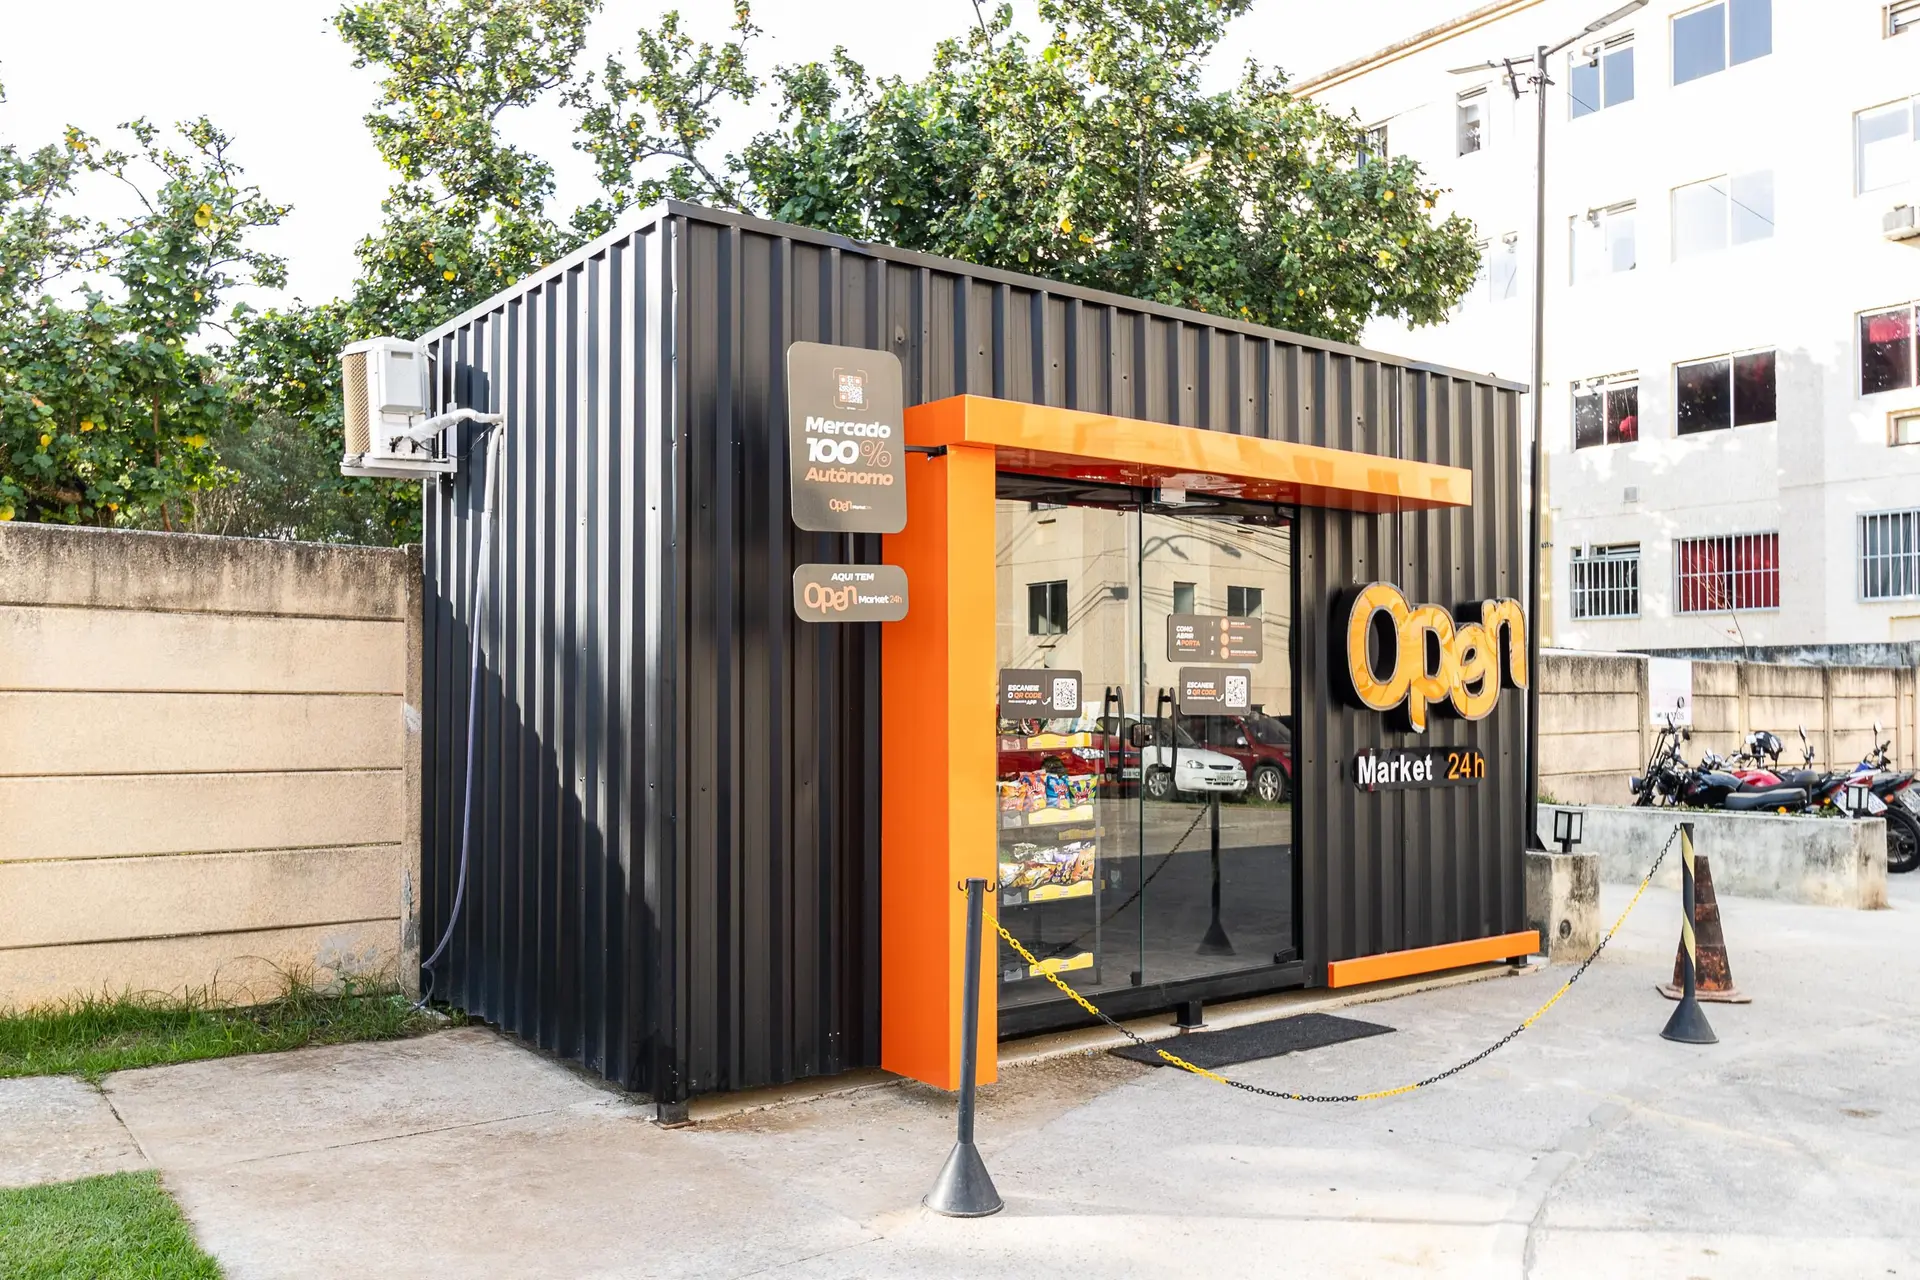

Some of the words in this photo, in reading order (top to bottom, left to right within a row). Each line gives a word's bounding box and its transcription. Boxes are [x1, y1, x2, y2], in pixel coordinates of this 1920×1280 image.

[805, 416, 891, 439] Mercado
[806, 437, 892, 467] 100%
[805, 467, 894, 486] Autônomo
[829, 499, 853, 512] Open
[831, 573, 854, 582] AQUI
[855, 573, 875, 582] TEM
[804, 582, 858, 614] Open
[858, 595, 889, 604] Market
[1347, 581, 1529, 734] Open
[1358, 754, 1433, 785] Market
